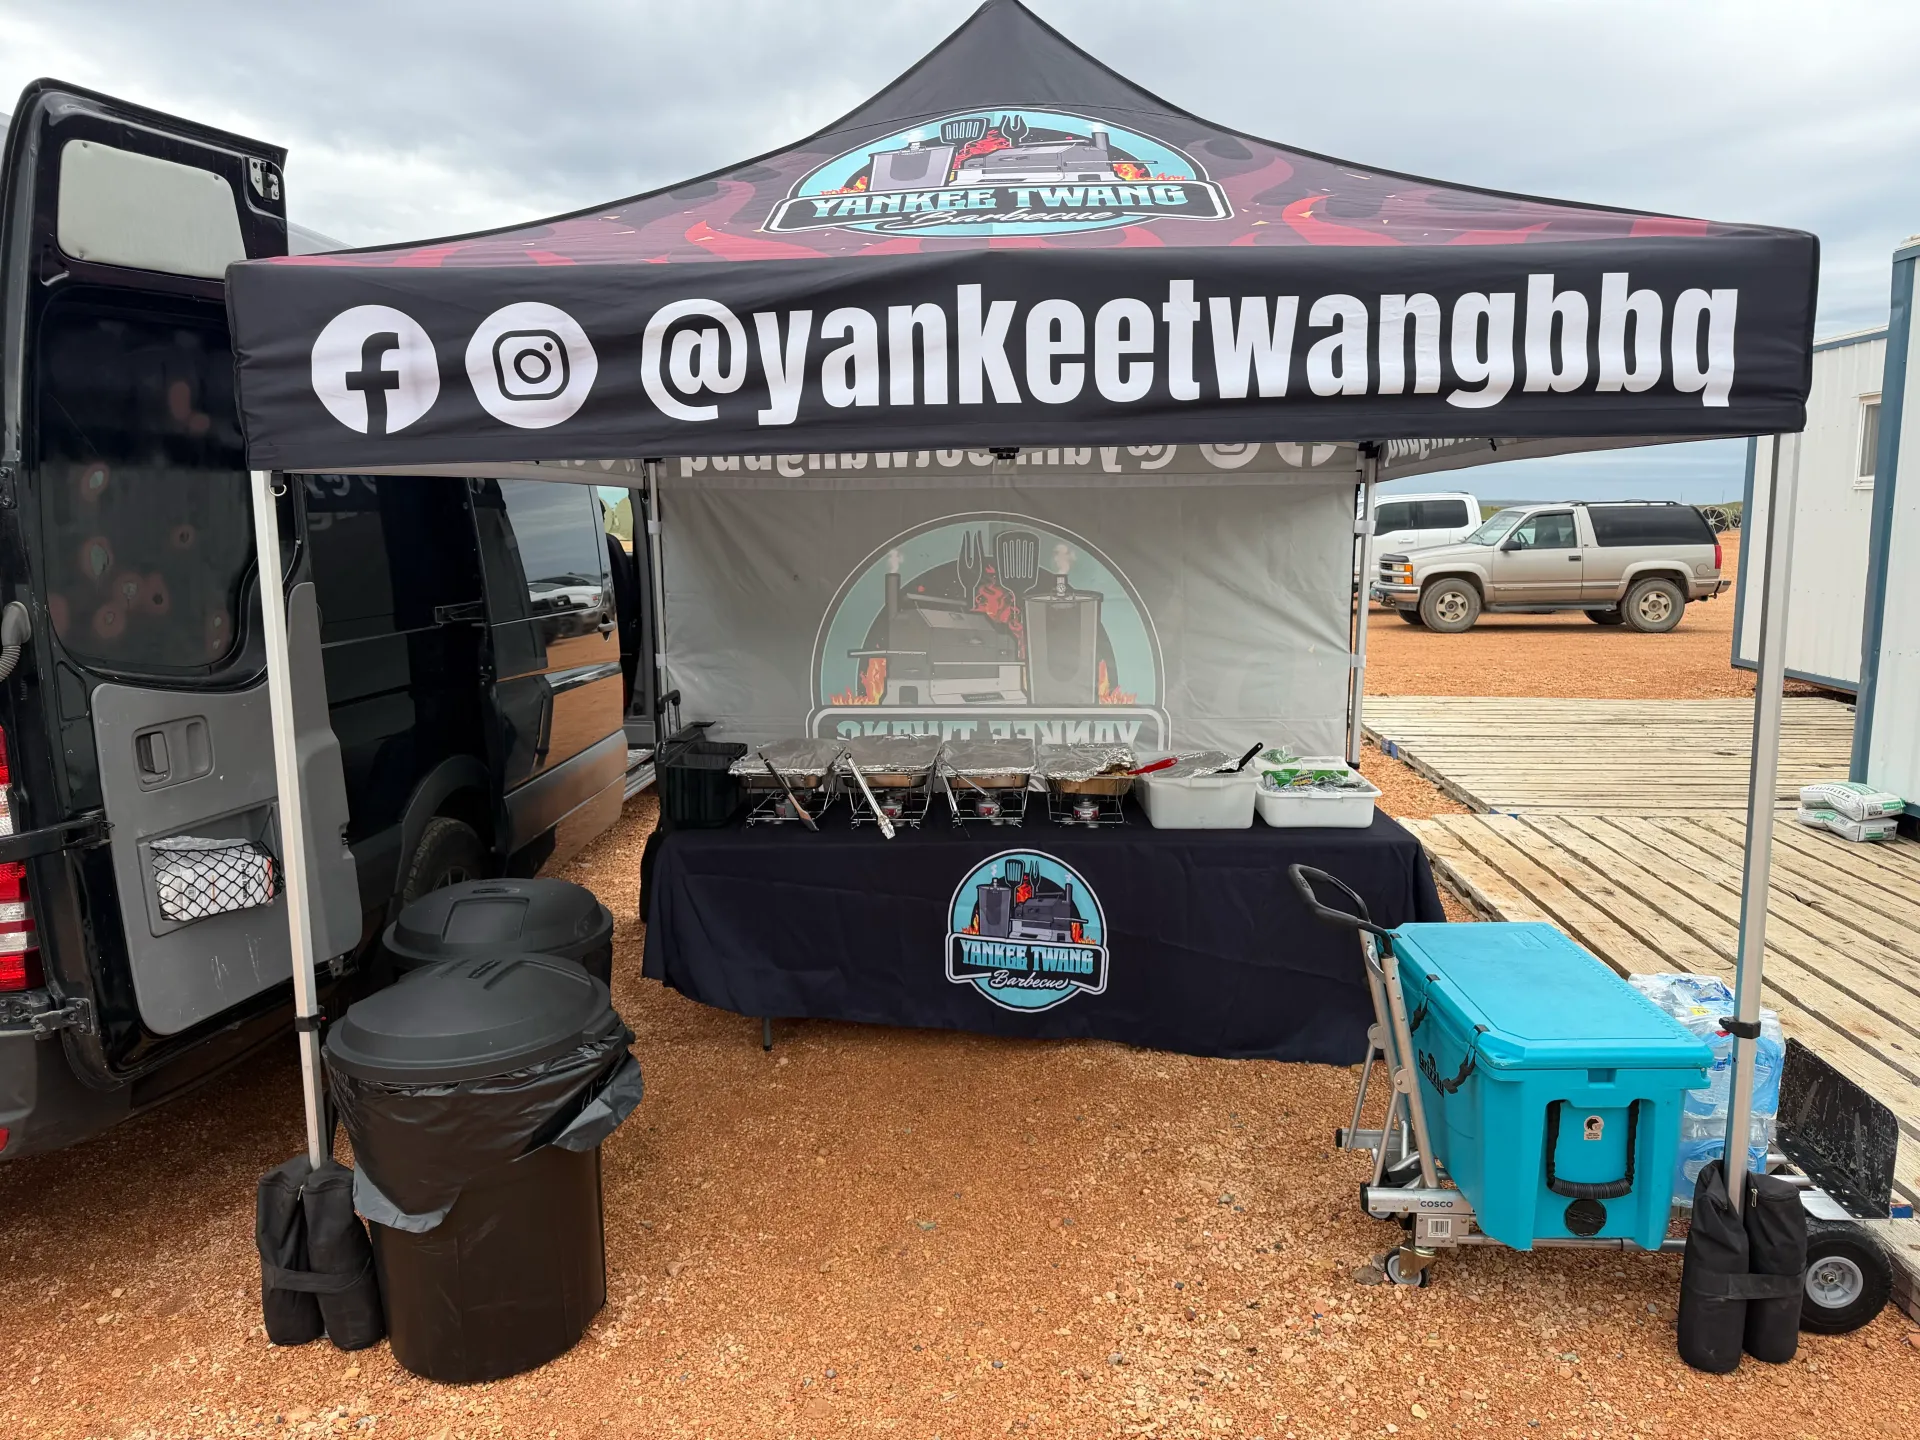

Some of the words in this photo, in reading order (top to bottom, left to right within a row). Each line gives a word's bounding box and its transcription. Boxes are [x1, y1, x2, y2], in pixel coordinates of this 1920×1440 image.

[811, 189, 996, 217] YANKEE
[1006, 184, 1188, 206] TWANG
[886, 206, 1116, 228] Barbecue
[640, 272, 1739, 426] @yankeetwangbbq
[960, 939, 1028, 970] YANKEE
[1030, 947, 1094, 974] TWANG
[989, 970, 1069, 989] Barbecue
[1420, 1200, 1453, 1208] COSCO
